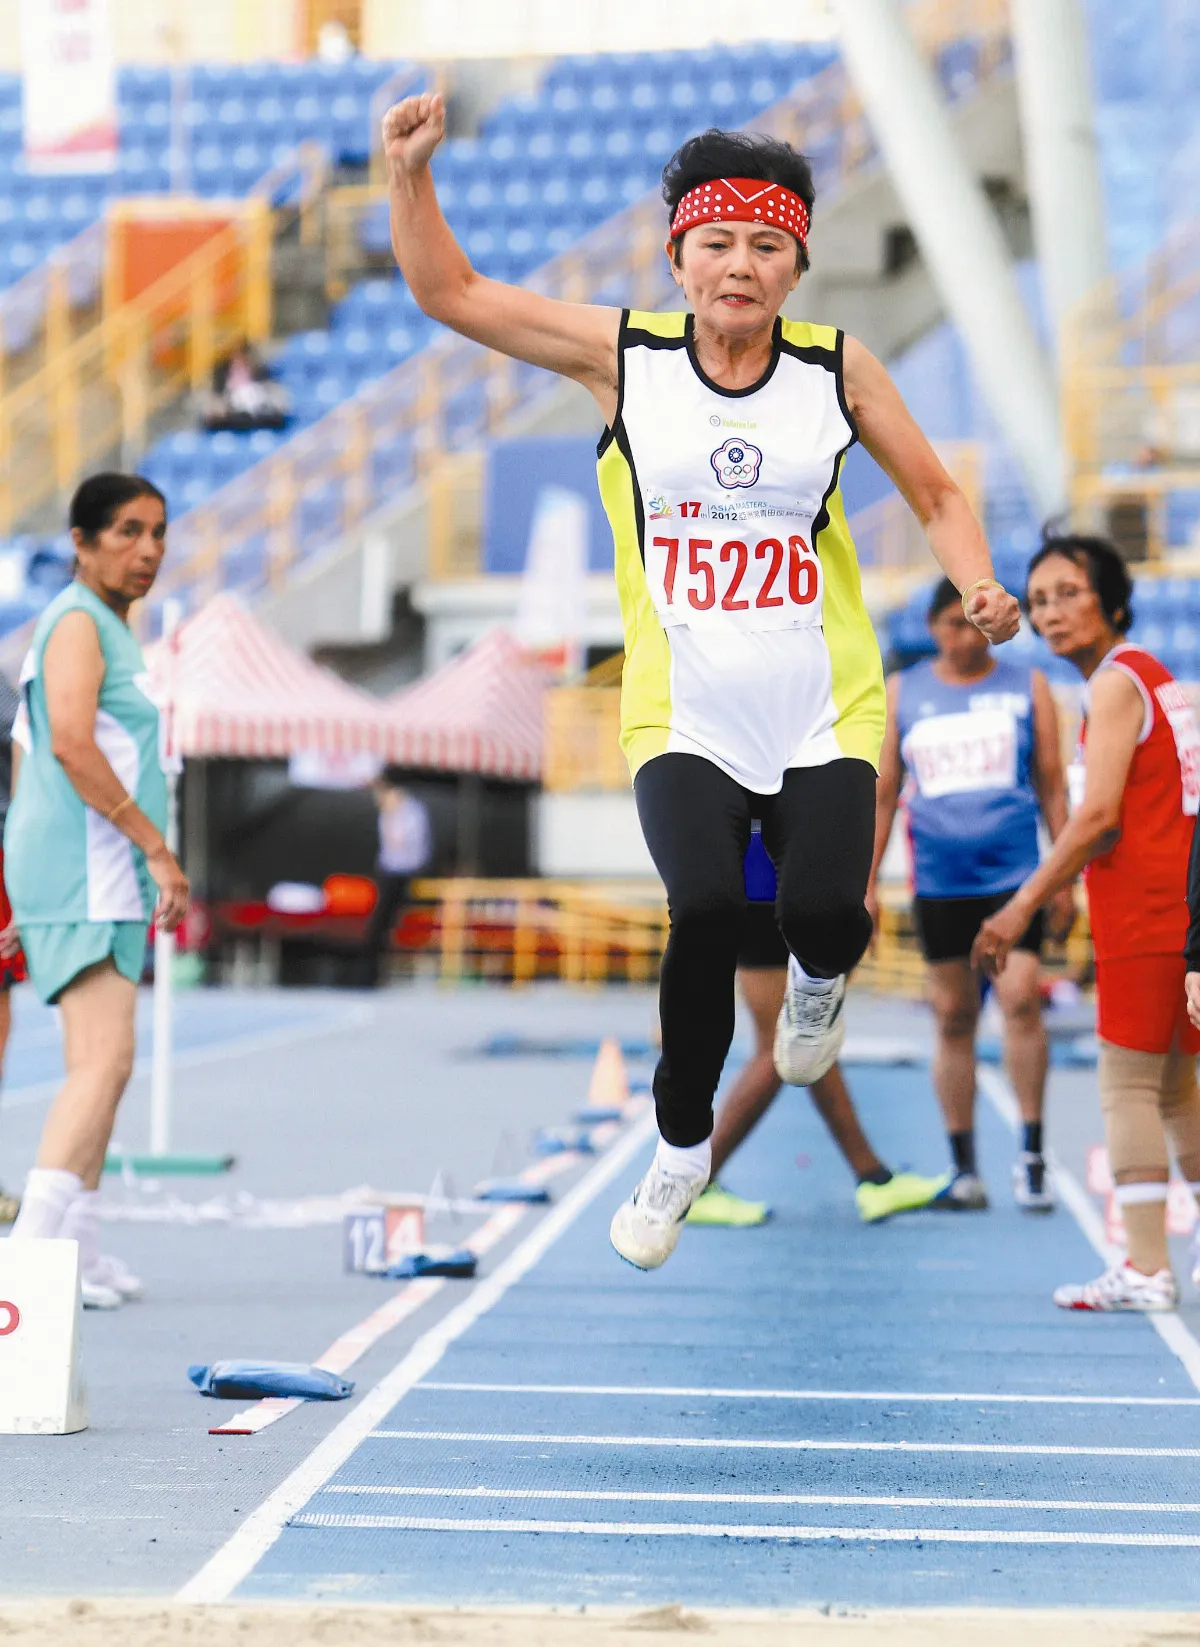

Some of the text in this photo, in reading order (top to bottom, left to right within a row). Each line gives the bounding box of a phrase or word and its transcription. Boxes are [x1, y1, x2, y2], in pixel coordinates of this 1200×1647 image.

[712, 511, 738, 521] 2012
[736, 501, 767, 511] MASTERS
[652, 535, 818, 611] 75226
[349, 1218, 388, 1272] 12
[389, 1212, 422, 1262] 4
